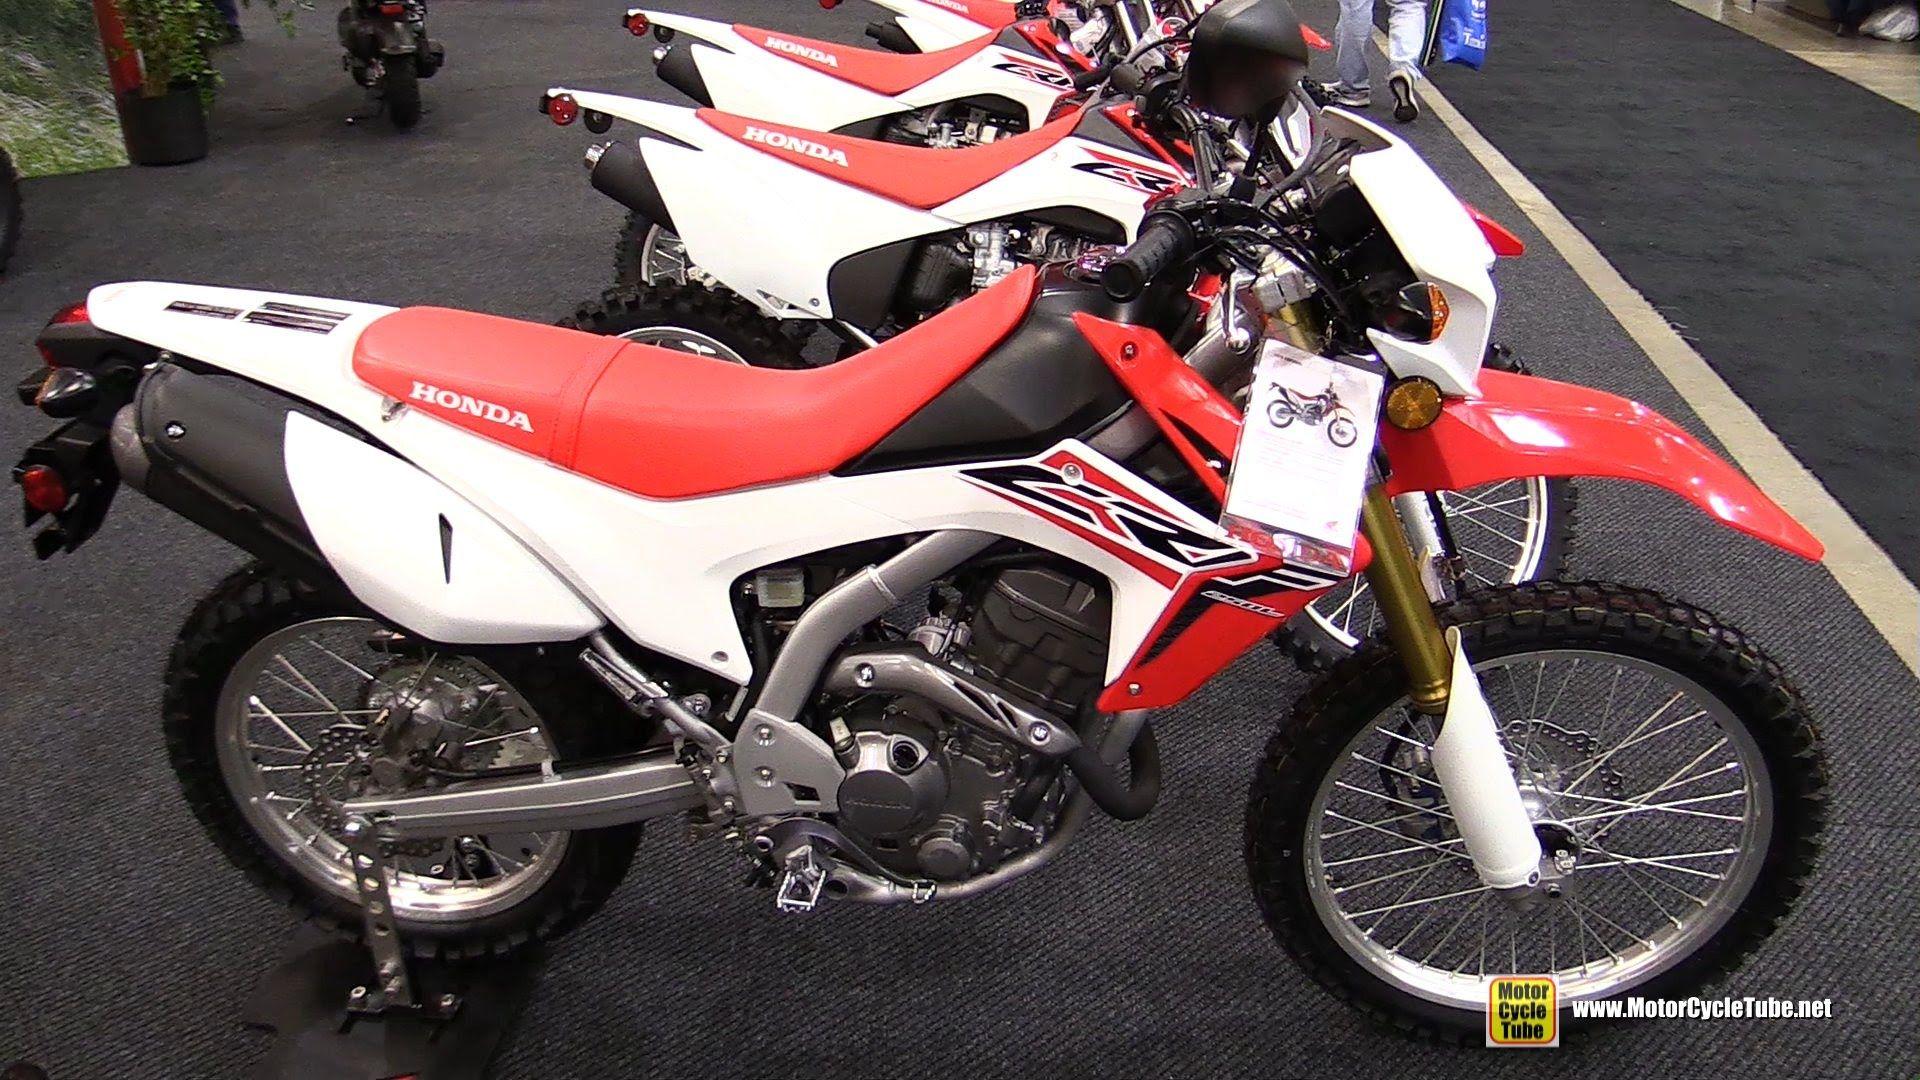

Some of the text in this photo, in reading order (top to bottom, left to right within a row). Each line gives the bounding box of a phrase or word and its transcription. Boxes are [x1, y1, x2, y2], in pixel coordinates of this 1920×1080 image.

[764, 36, 839, 68] HONDA
[742, 125, 849, 168] HONDA
[408, 380, 535, 433] HONDA
